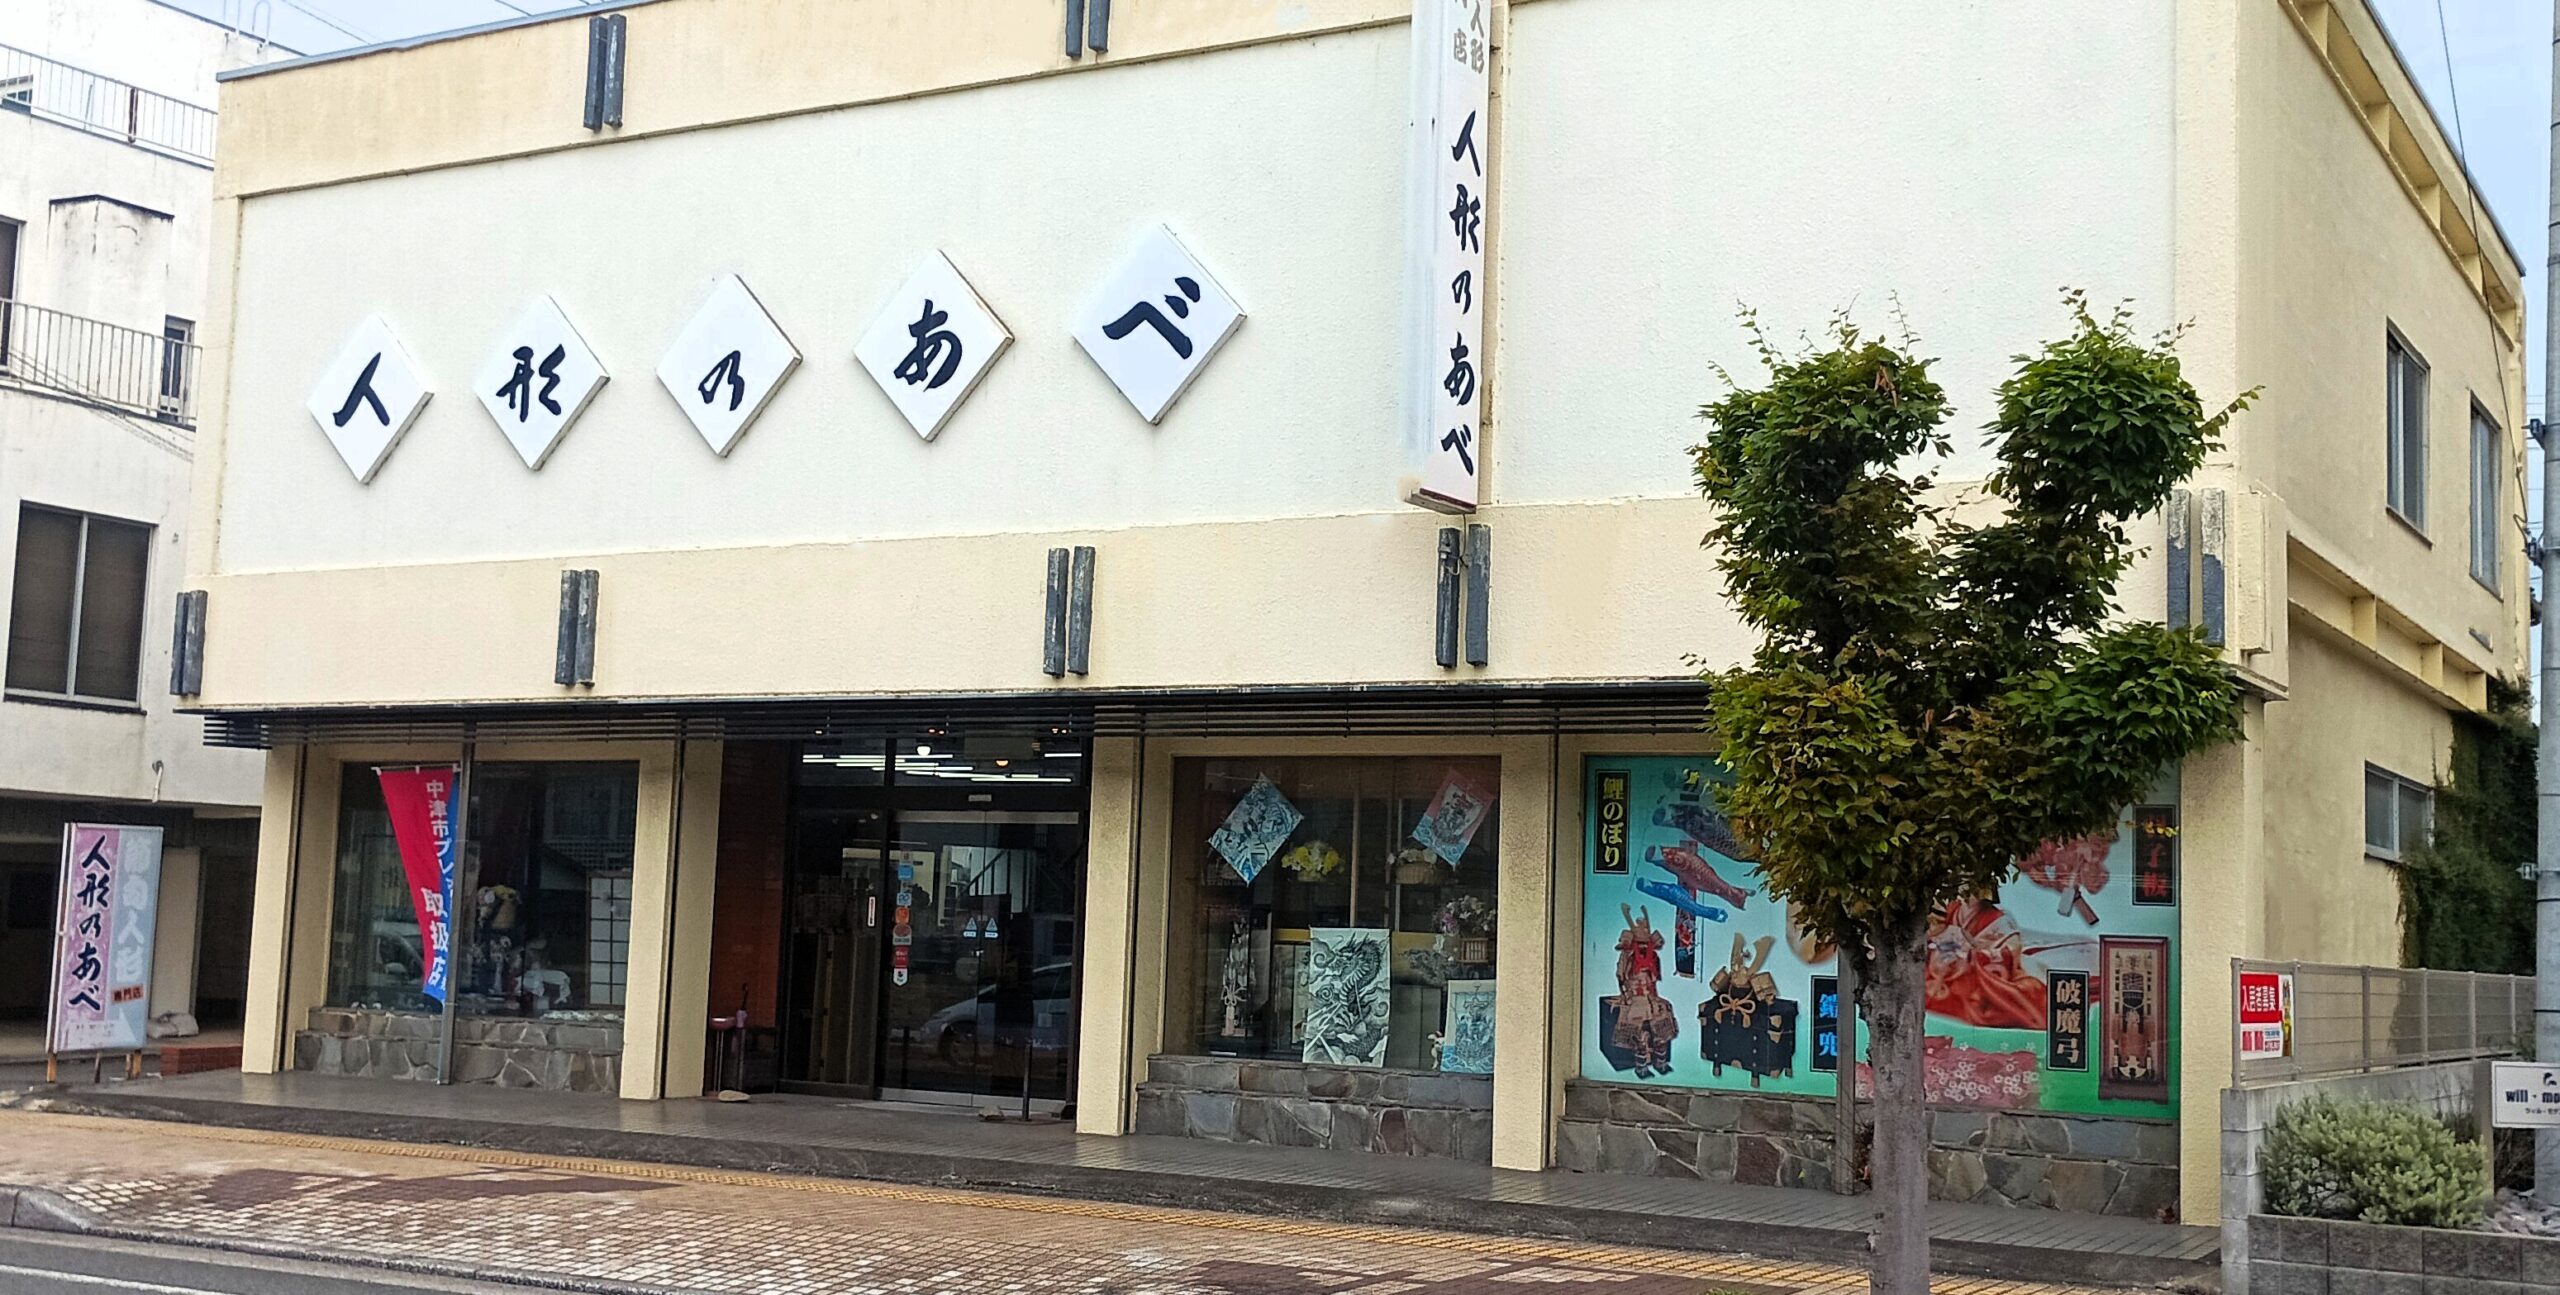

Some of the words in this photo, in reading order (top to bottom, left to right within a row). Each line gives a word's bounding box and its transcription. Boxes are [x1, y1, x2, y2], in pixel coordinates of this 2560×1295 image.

[1440, 109, 1482, 477] 人形のあべ
[1602, 777, 1624, 868] 鯉のぼり
[68, 834, 111, 1012] 人形のあべ
[2055, 978, 2082, 1064] 破魔弓
